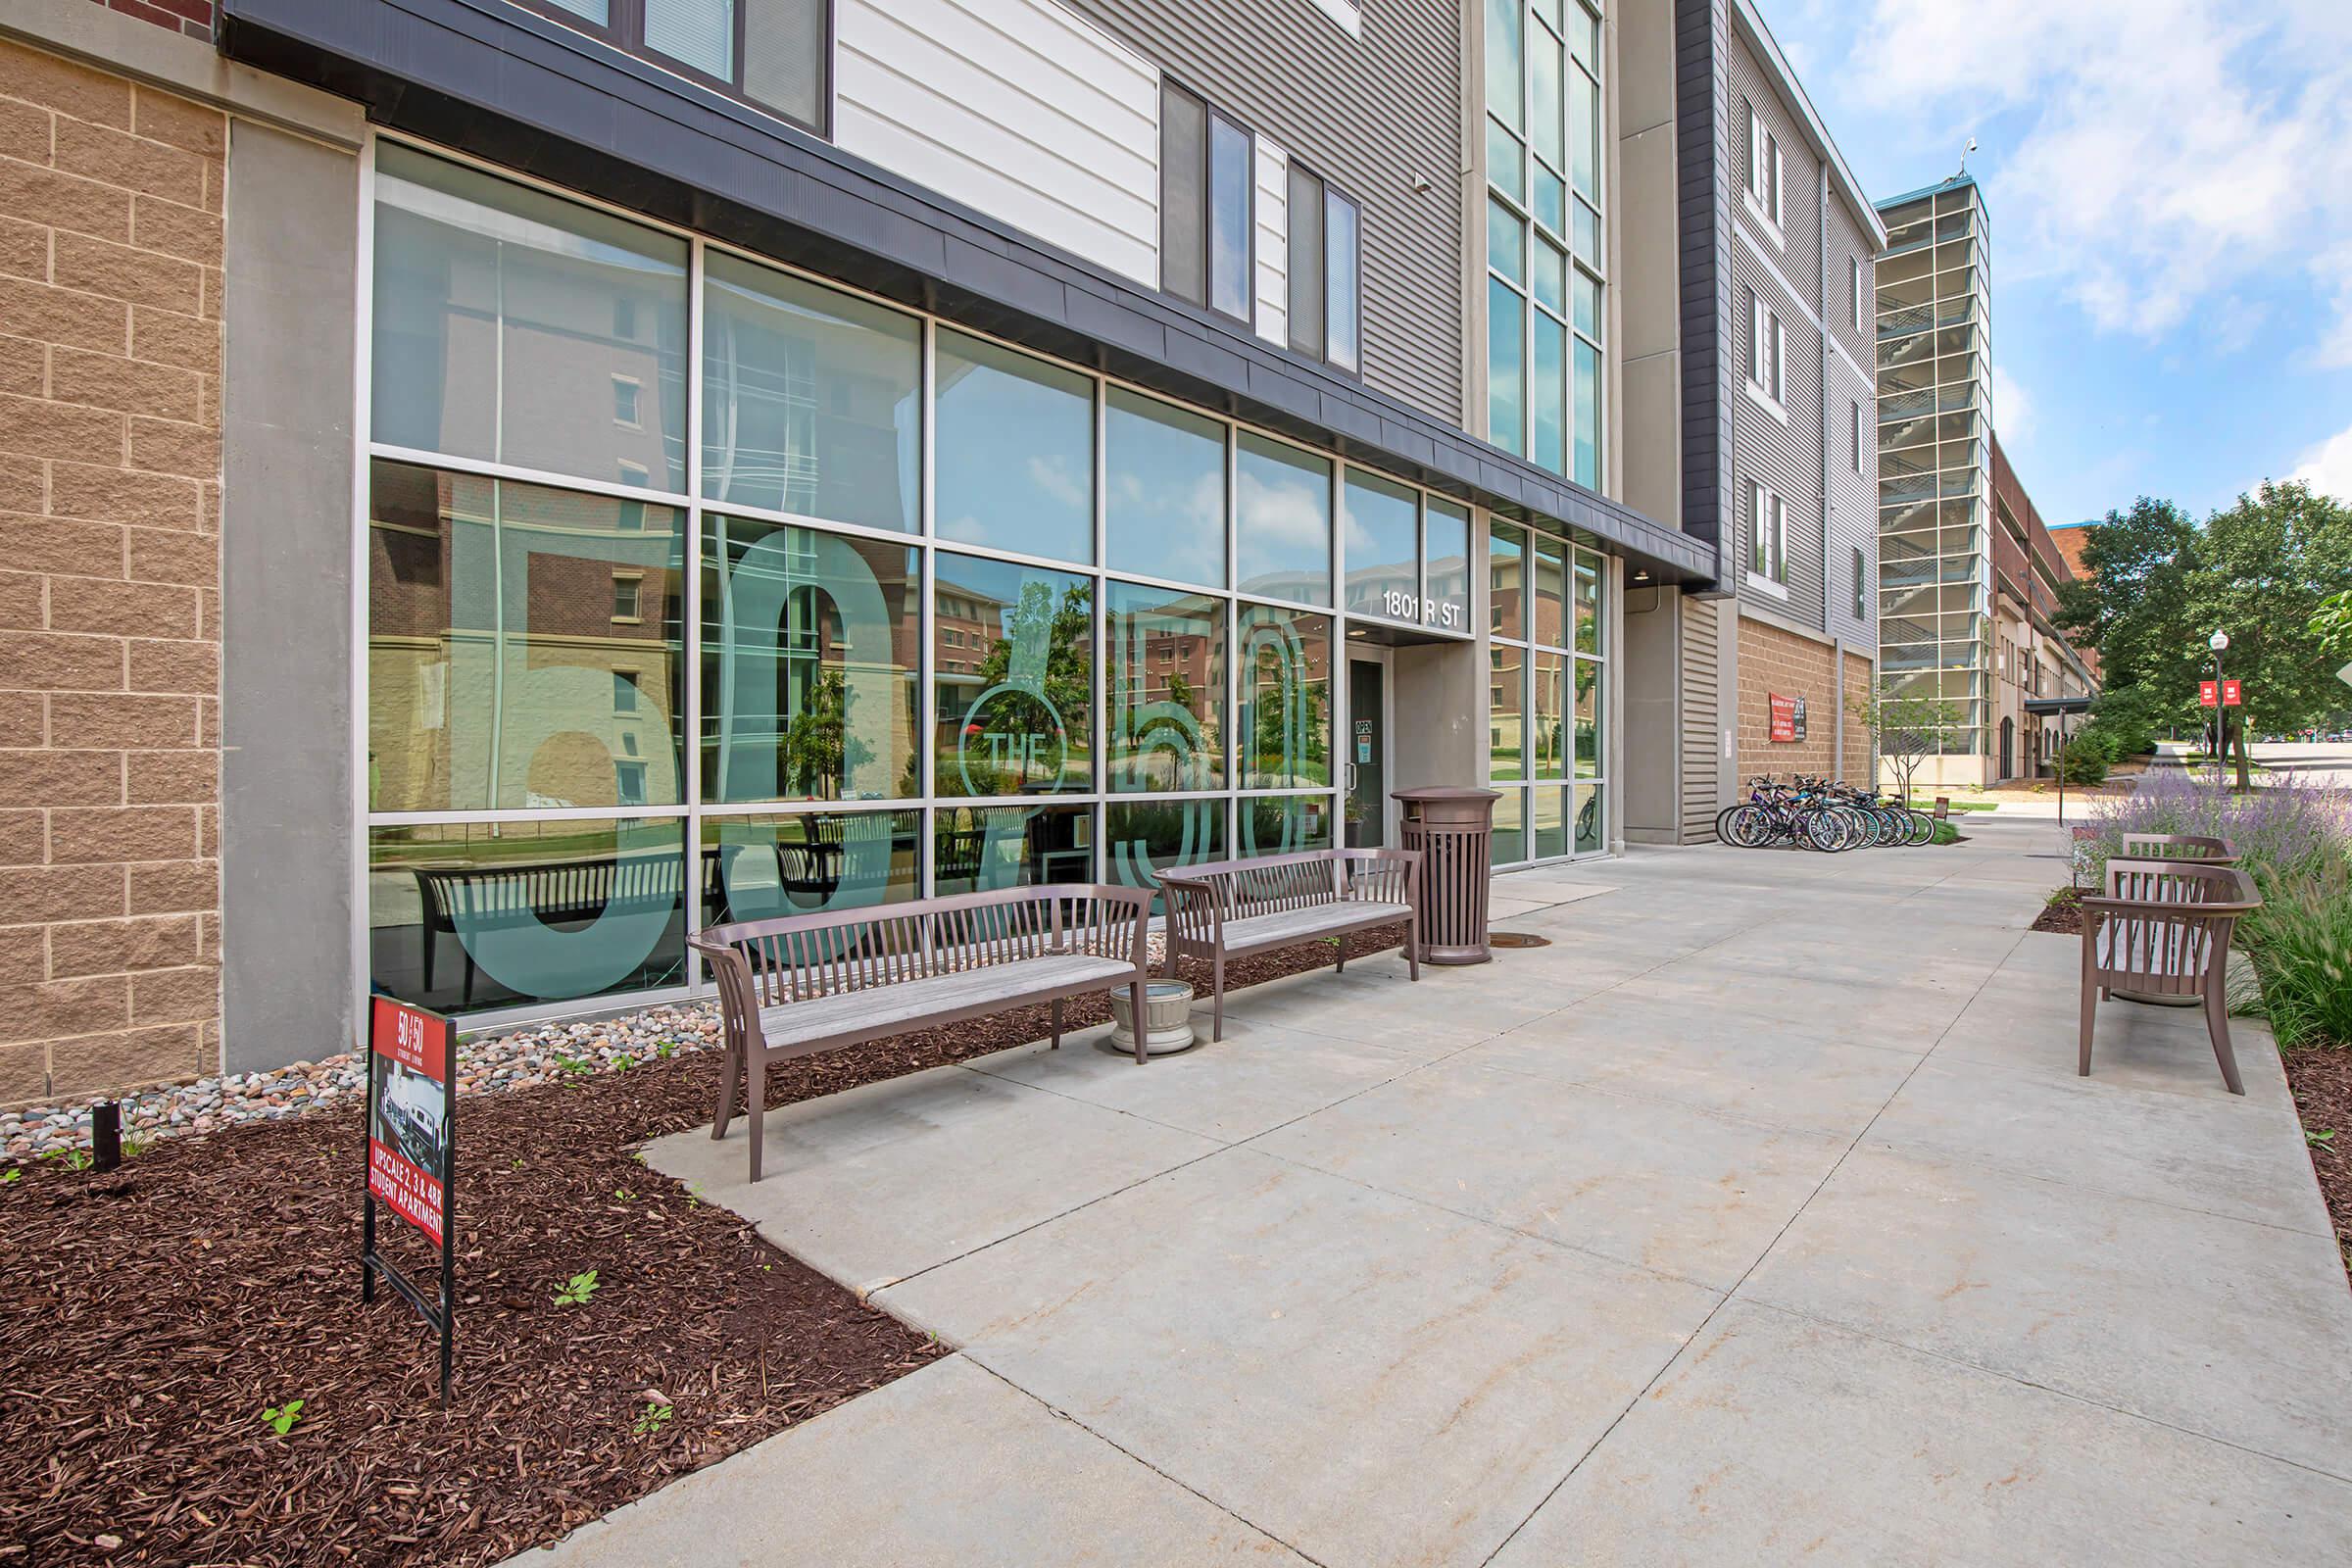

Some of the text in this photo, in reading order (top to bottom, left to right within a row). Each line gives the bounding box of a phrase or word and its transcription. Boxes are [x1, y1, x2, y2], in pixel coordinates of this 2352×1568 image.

[1383, 590, 1460, 627] 1801 R ST
[1356, 721, 1372, 733] OPEN
[983, 733, 1046, 771] THE
[398, 1010, 423, 1054] 50/50
[374, 1146, 404, 1183] UPSCALE
[414, 1172, 418, 1194] 3
[419, 1178, 425, 1199] &
[427, 1183, 441, 1210] 4BR
[370, 1165, 443, 1236] STUDENT APARTMENT
